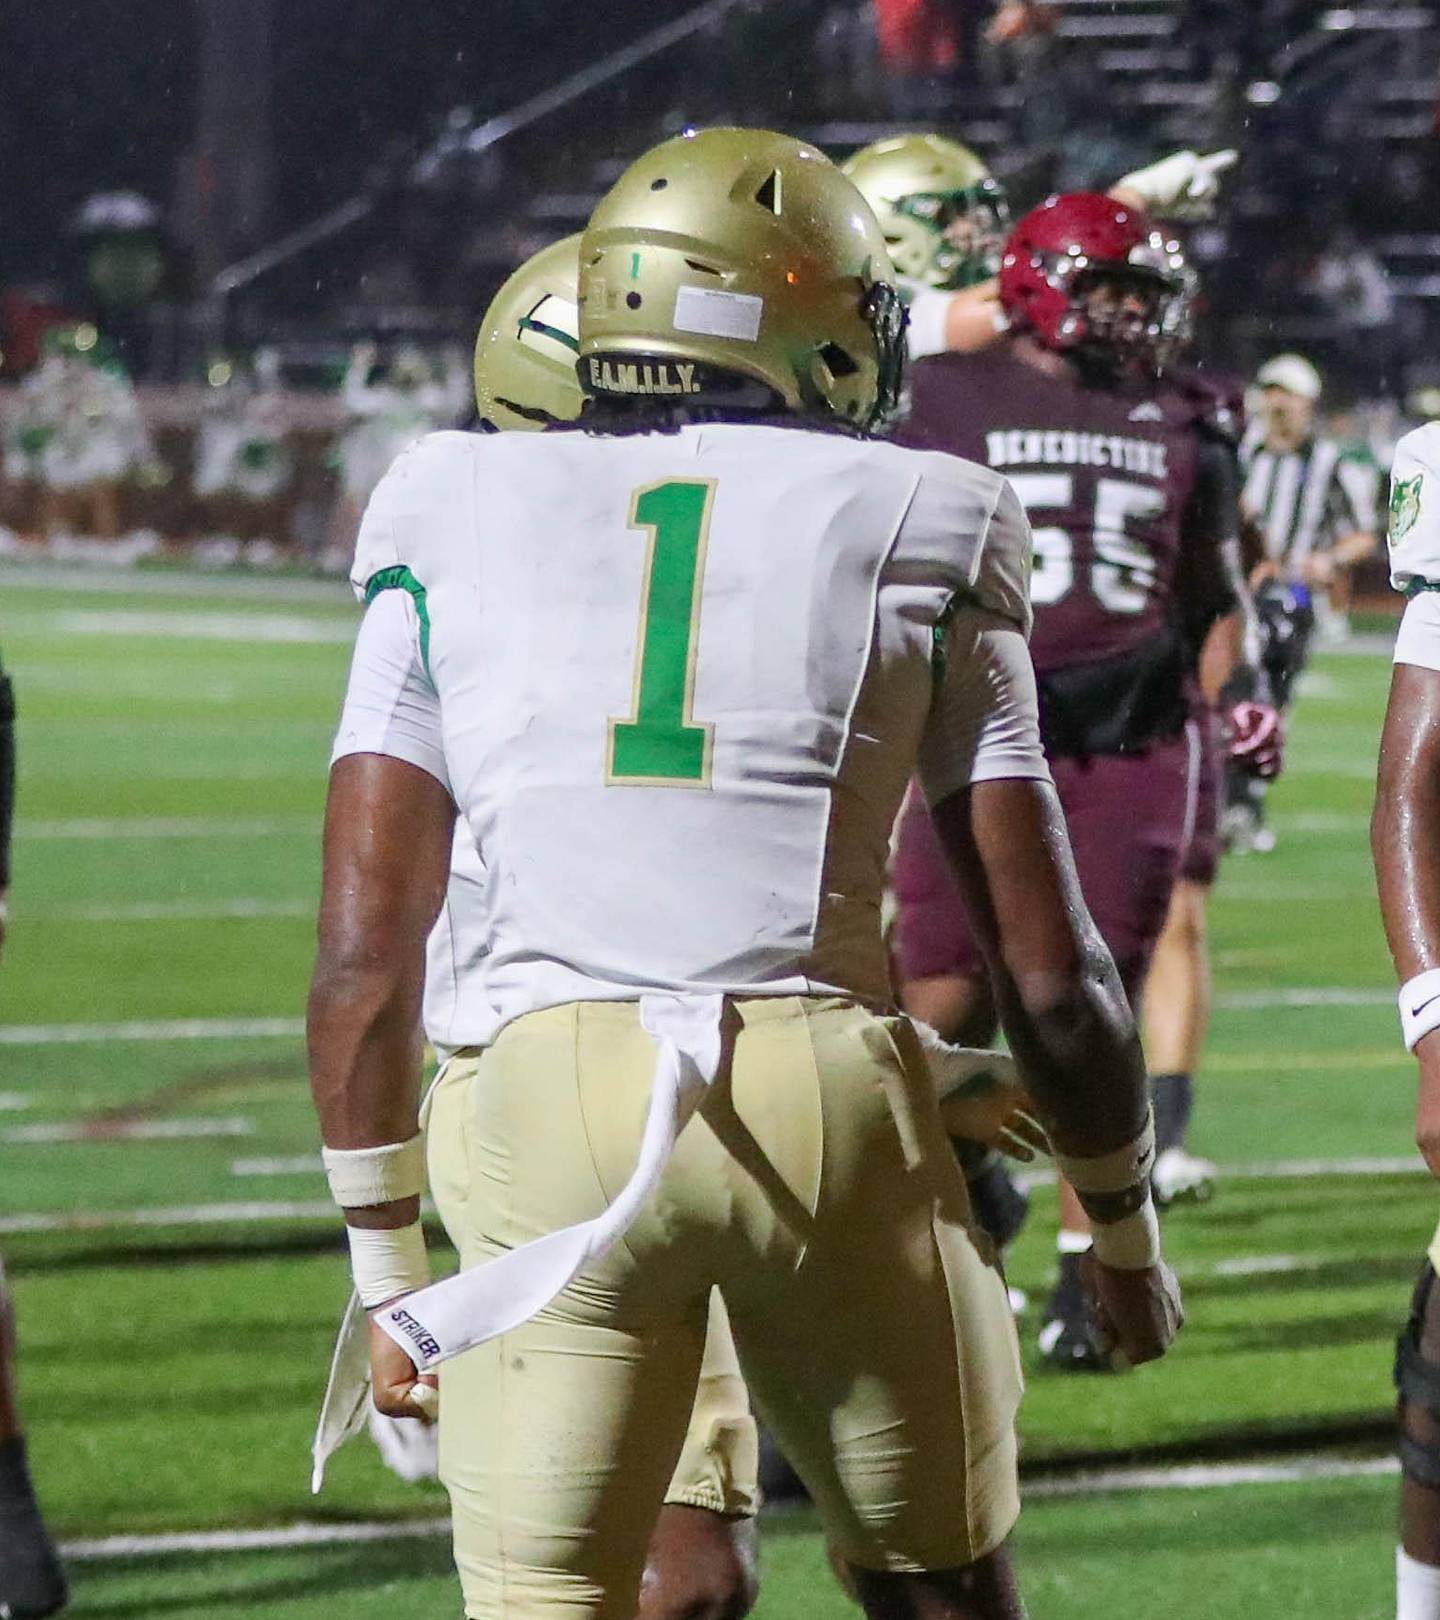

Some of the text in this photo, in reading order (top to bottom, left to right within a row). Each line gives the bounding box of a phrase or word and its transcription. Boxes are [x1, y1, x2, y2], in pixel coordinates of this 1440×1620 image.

[1004, 472, 1166, 614] 55
[605, 475, 719, 790] 1
[391, 1310, 441, 1360] STRIKER
